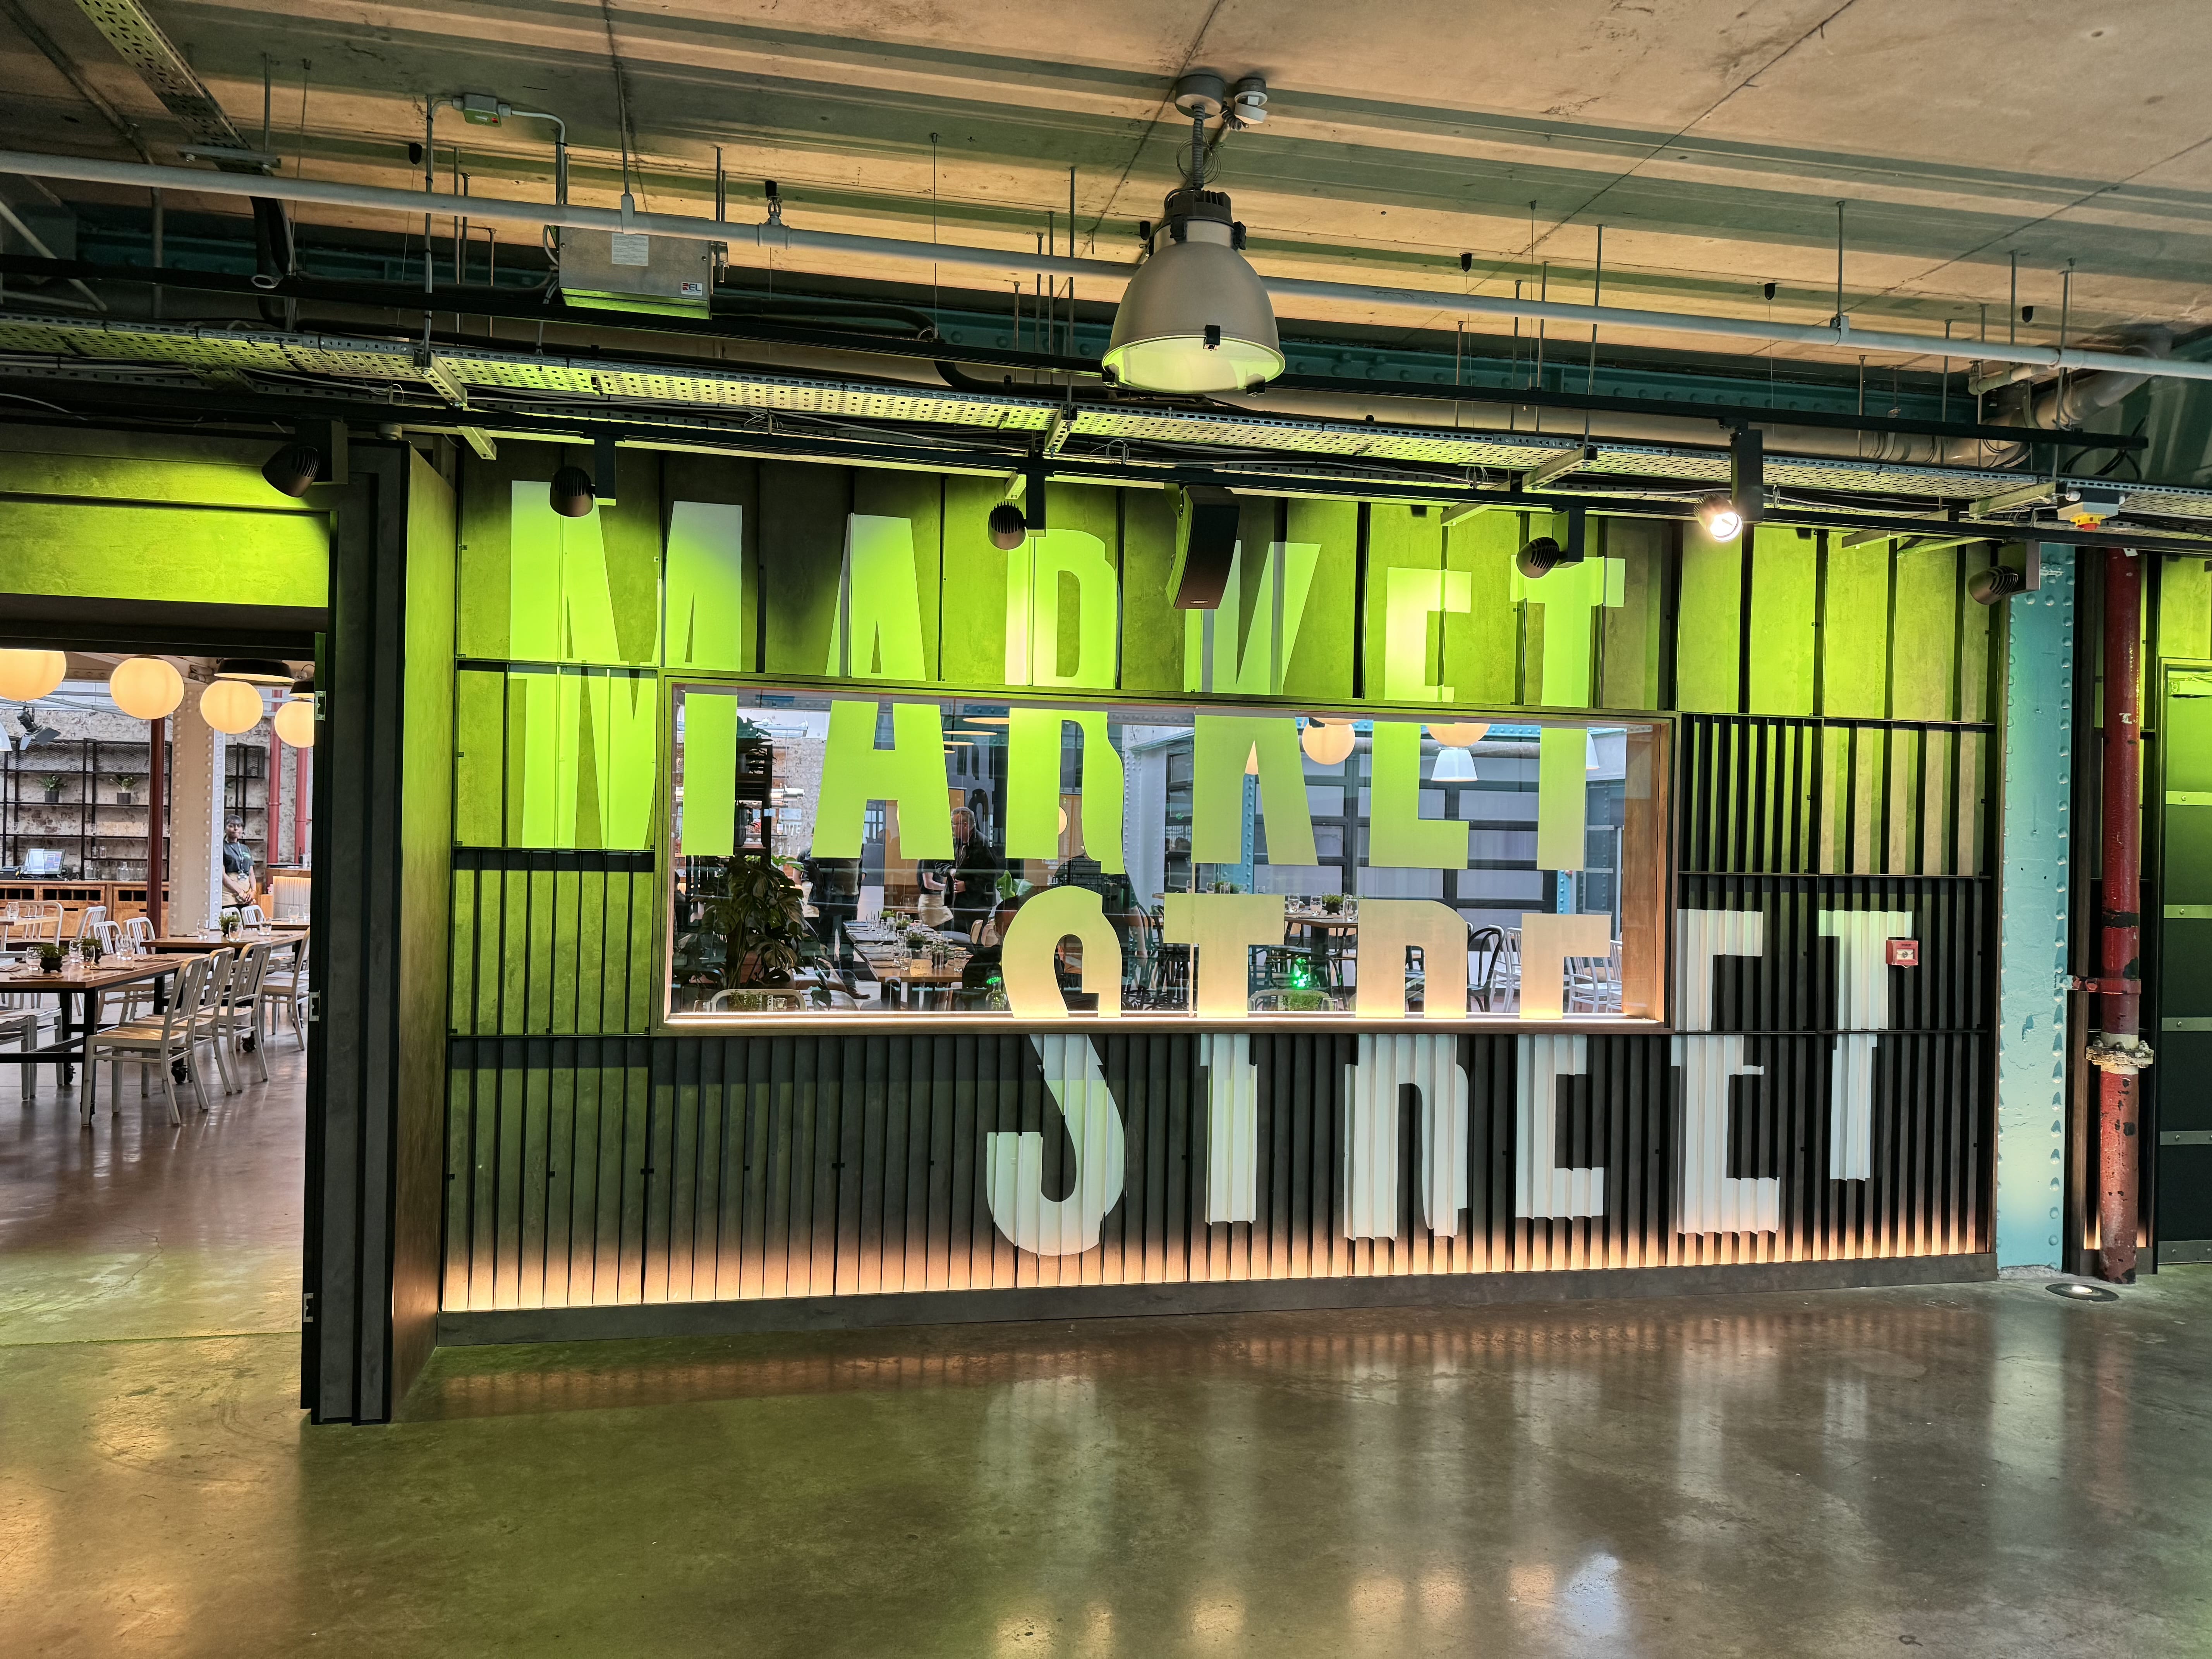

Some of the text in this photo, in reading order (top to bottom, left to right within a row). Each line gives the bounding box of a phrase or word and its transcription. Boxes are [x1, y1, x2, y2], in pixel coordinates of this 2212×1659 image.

[682, 283, 701, 292] REL
[511, 480, 1626, 874] MARKET
[986, 885, 1912, 1255] STREET
